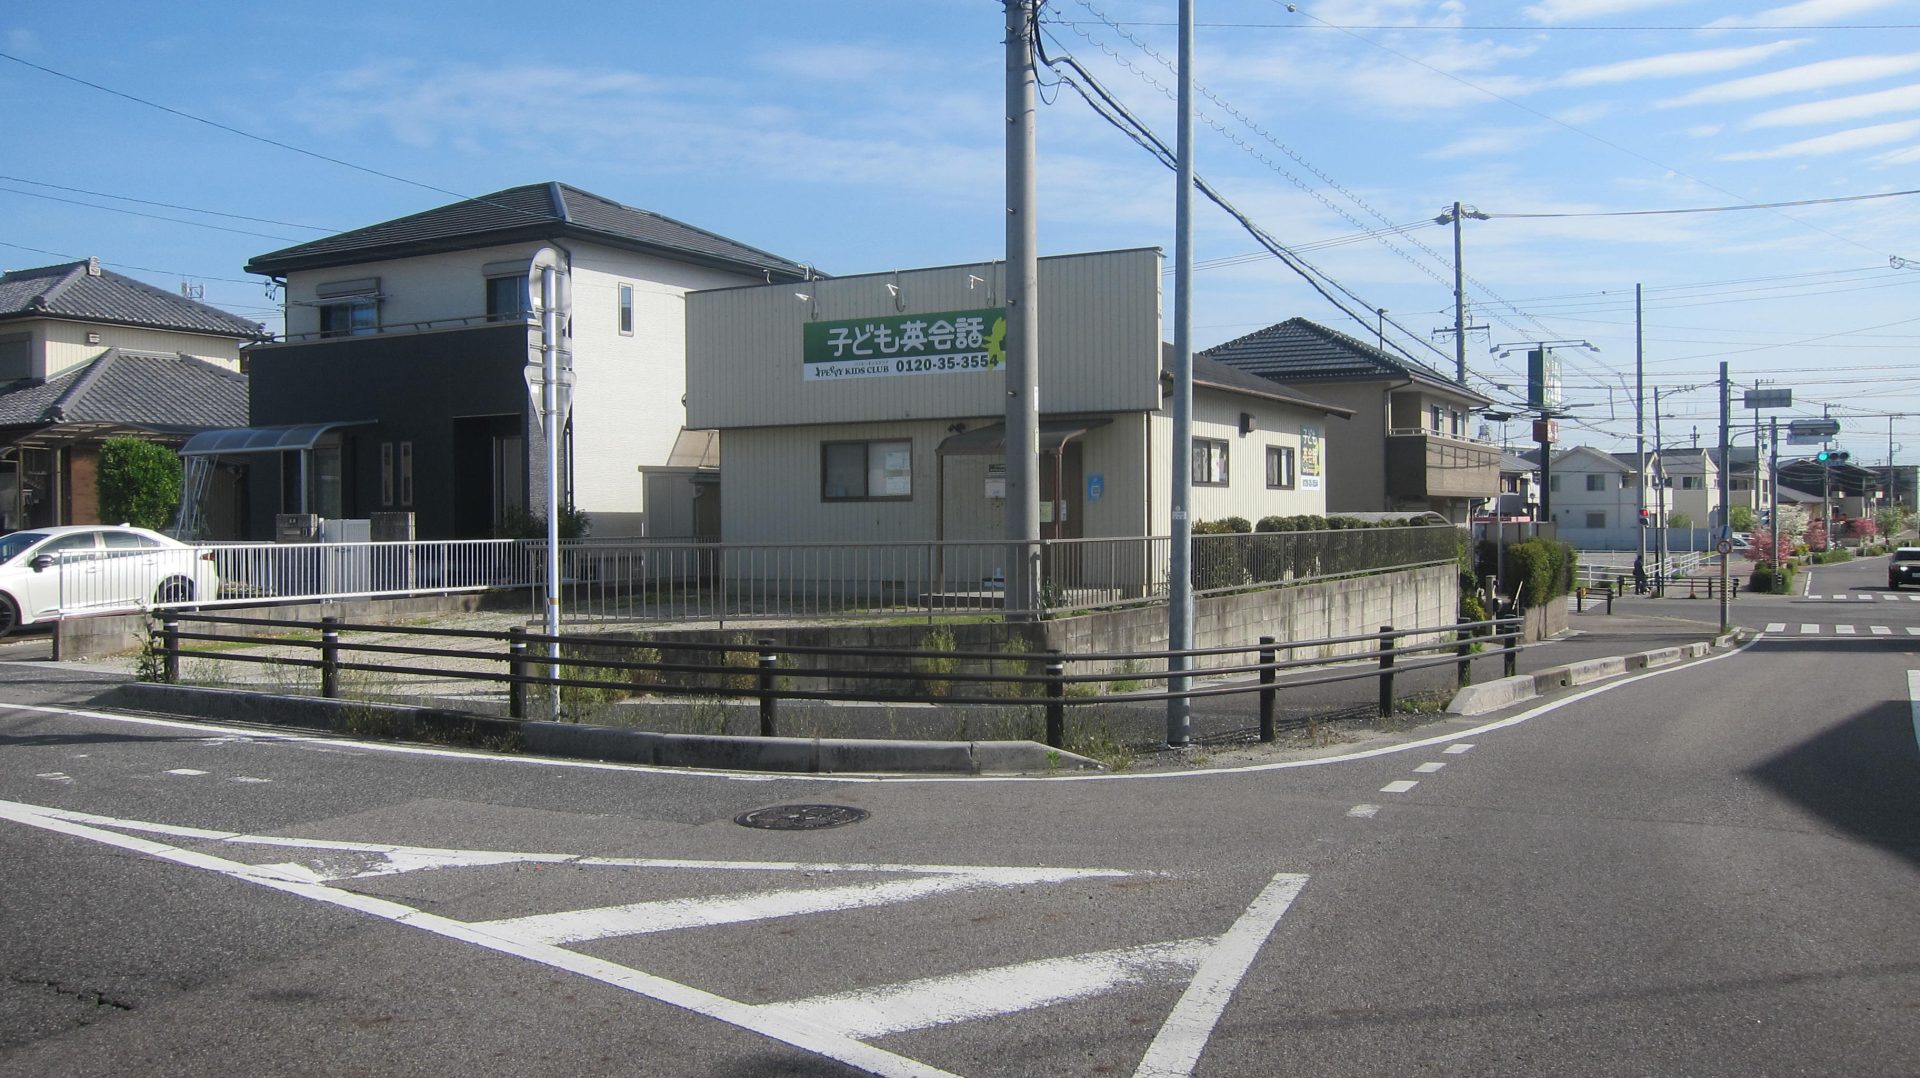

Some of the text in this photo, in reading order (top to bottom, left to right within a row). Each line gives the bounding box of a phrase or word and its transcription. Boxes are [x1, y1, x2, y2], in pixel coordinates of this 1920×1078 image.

[827, 317, 984, 357] 子ども英会話
[845, 367, 865, 375] KIDS
[867, 366, 889, 374] CLUB
[896, 354, 999, 372] 0120-35-3554
